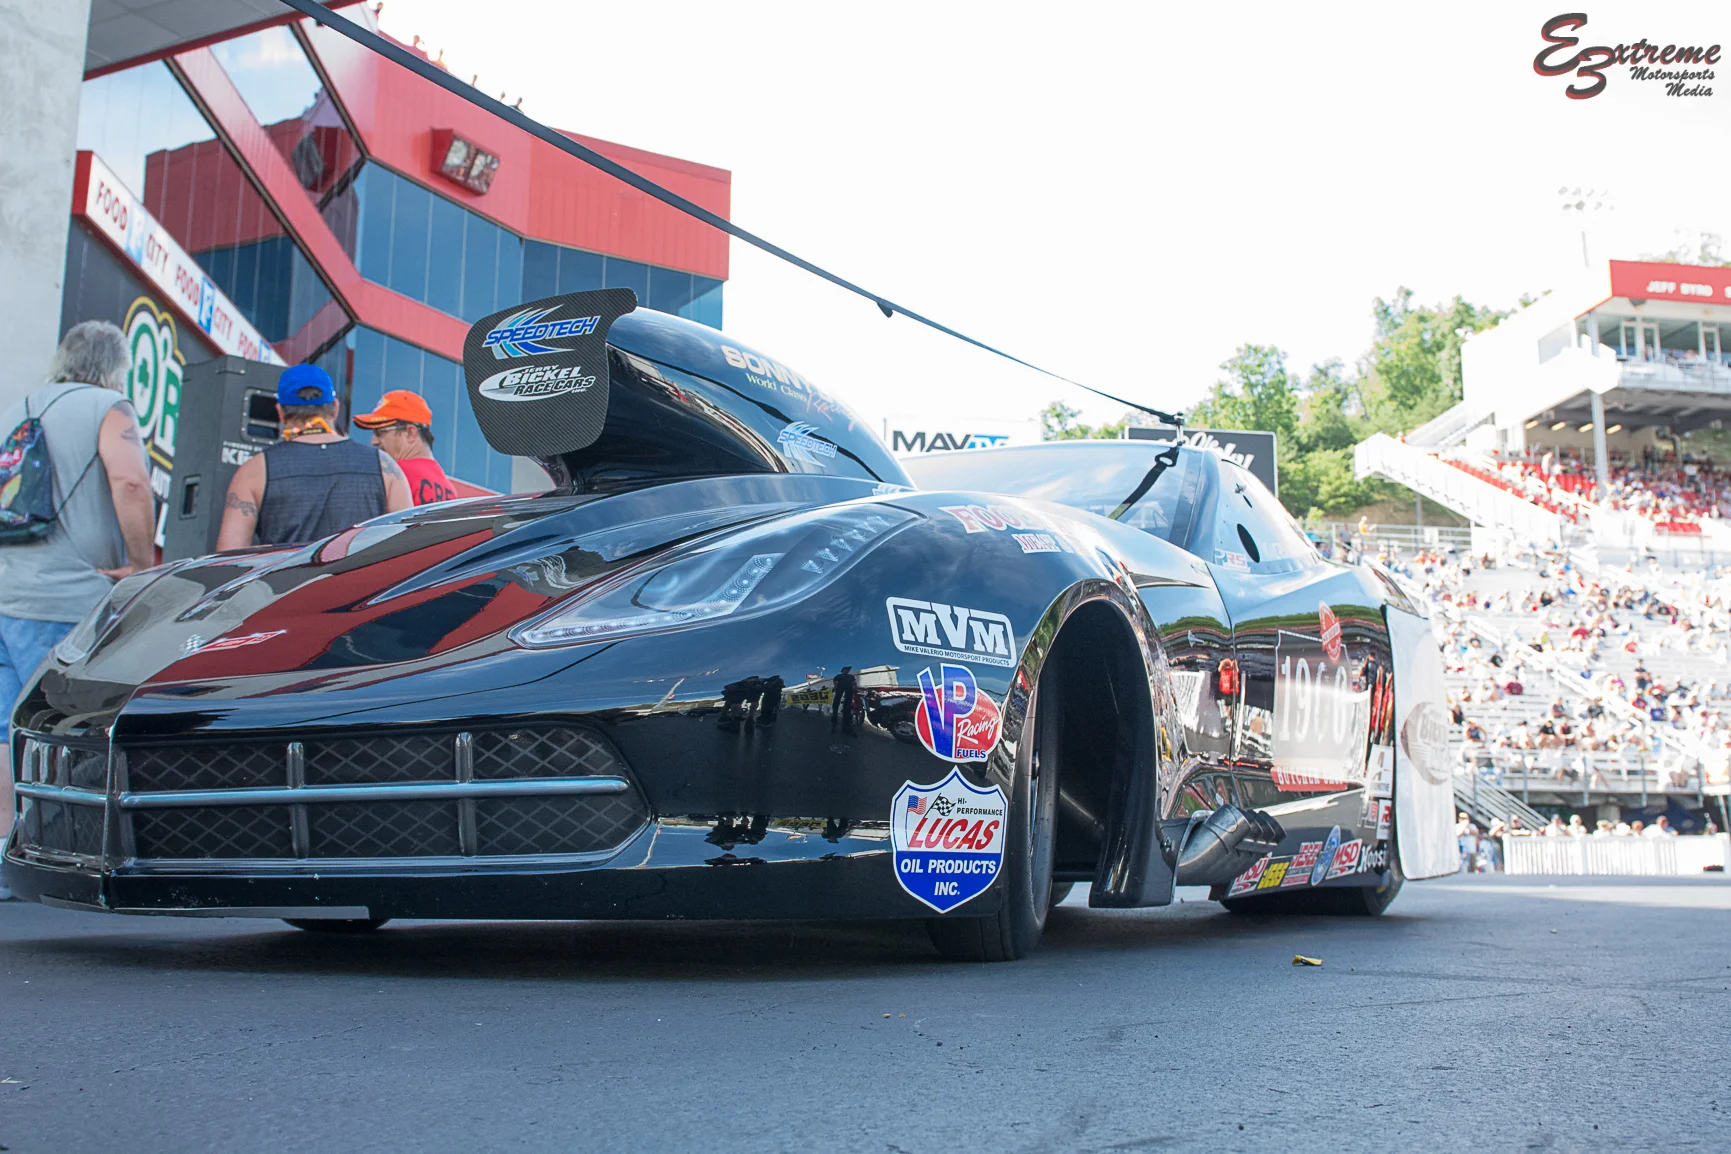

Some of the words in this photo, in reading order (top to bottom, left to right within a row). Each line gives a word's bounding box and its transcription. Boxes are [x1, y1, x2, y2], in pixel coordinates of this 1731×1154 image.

[96, 180, 128, 232] FOOD
[146, 233, 169, 274] CITY
[175, 264, 200, 307] FOOD
[482, 315, 601, 348] SPEEDTECH
[502, 366, 582, 387] BICKEL
[522, 364, 560, 374] JERRY
[513, 380, 555, 396] RACE
[553, 376, 597, 391] CARS
[745, 372, 777, 391] World
[776, 429, 838, 459] SPEEDTECH
[897, 602, 1009, 655] MVM
[904, 645, 919, 653] MIKE
[919, 647, 944, 656] VALERIO
[944, 652, 982, 662] MOTORSPORT
[982, 656, 1010, 666] PRODUCTS
[916, 662, 977, 759] VP
[956, 717, 1000, 747] Racing
[956, 748, 987, 759] FUELS
[957, 797, 968, 805] HI-
[956, 807, 1003, 817] PERFORMANCE
[908, 817, 1000, 850] LUCAS
[1331, 841, 1360, 869] MSD
[900, 858, 924, 874] OIL
[928, 859, 997, 875] PRODUCTS
[934, 881, 961, 896] INC.
